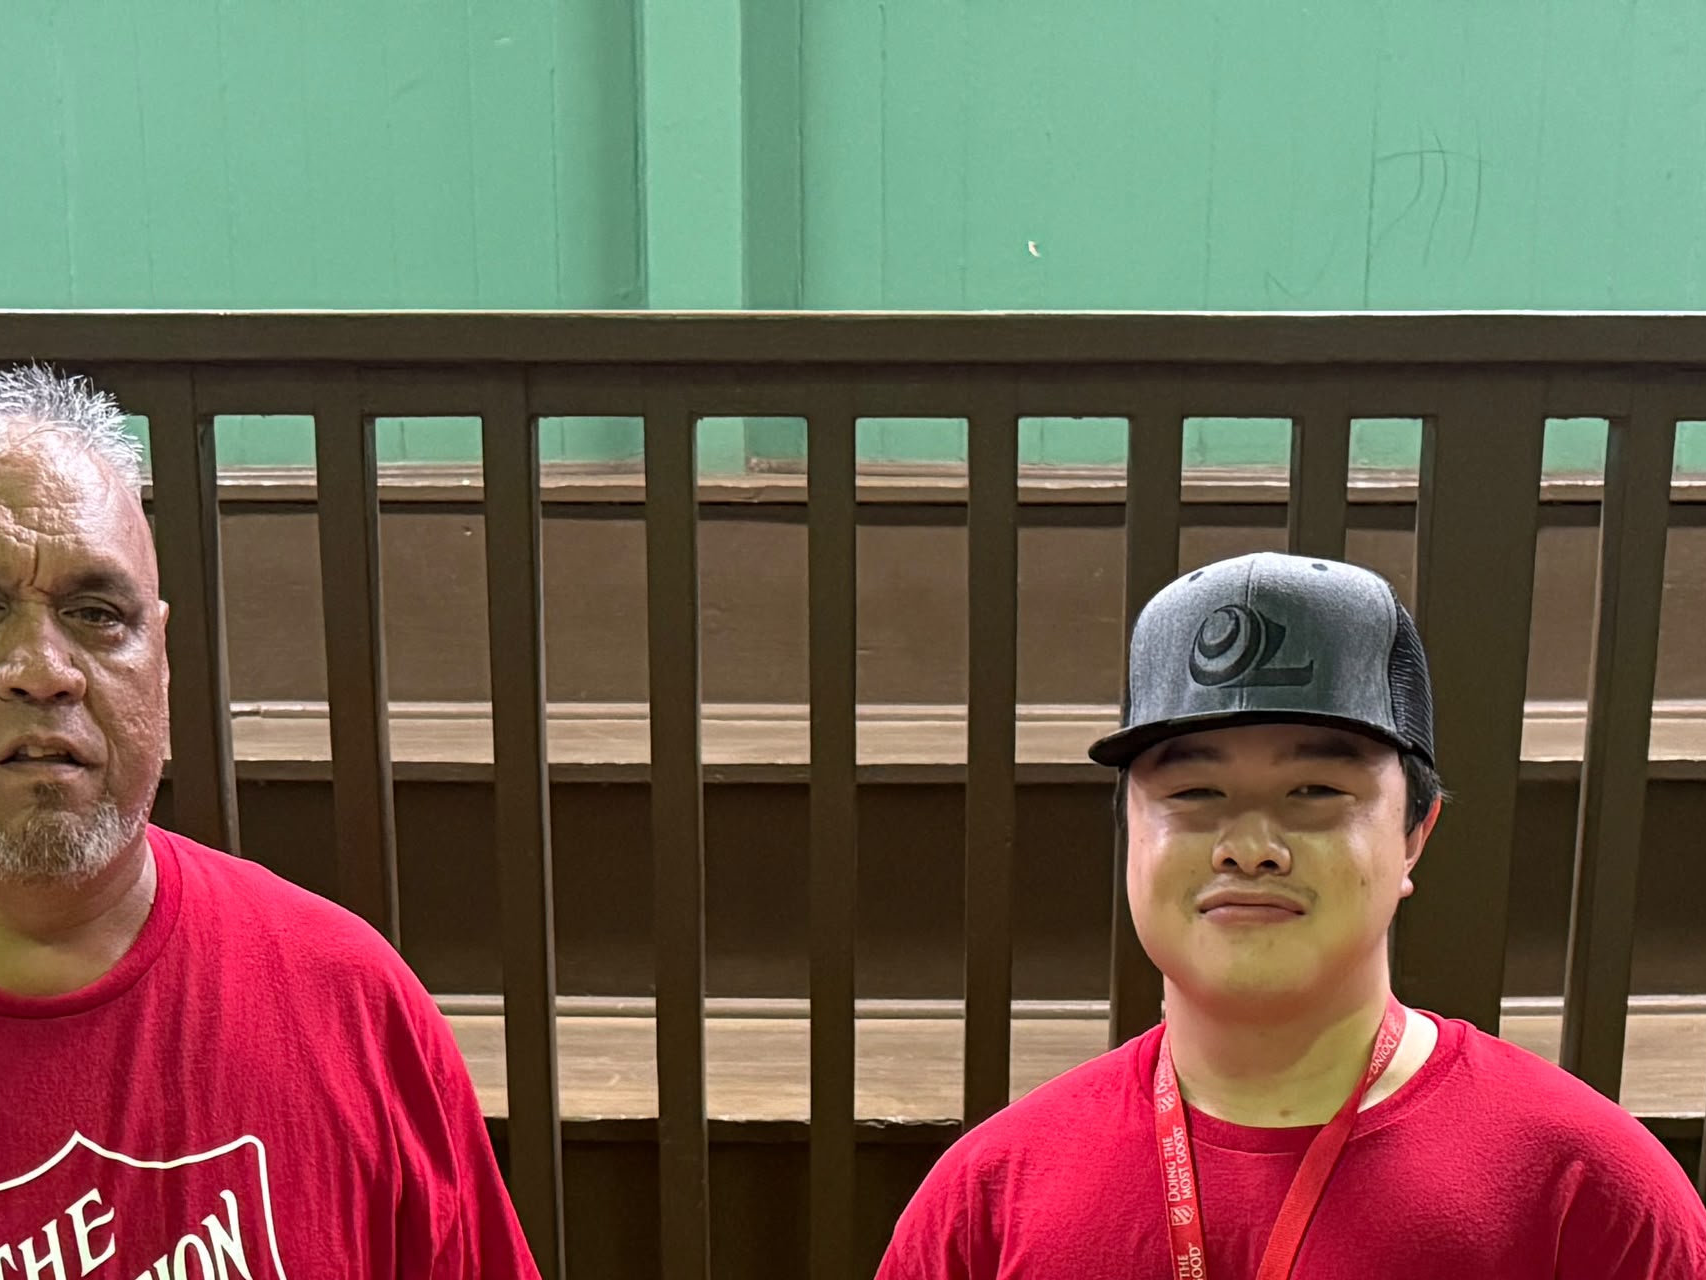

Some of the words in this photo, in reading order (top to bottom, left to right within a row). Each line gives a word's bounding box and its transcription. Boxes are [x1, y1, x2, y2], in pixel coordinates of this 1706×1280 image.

[1162, 1136, 1174, 1159] THE
[1173, 1127, 1187, 1164] GOOD
[1165, 1161, 1181, 1202] DOING
[1178, 1167, 1193, 1199] MOST
[1177, 1254, 1190, 1280] THE
